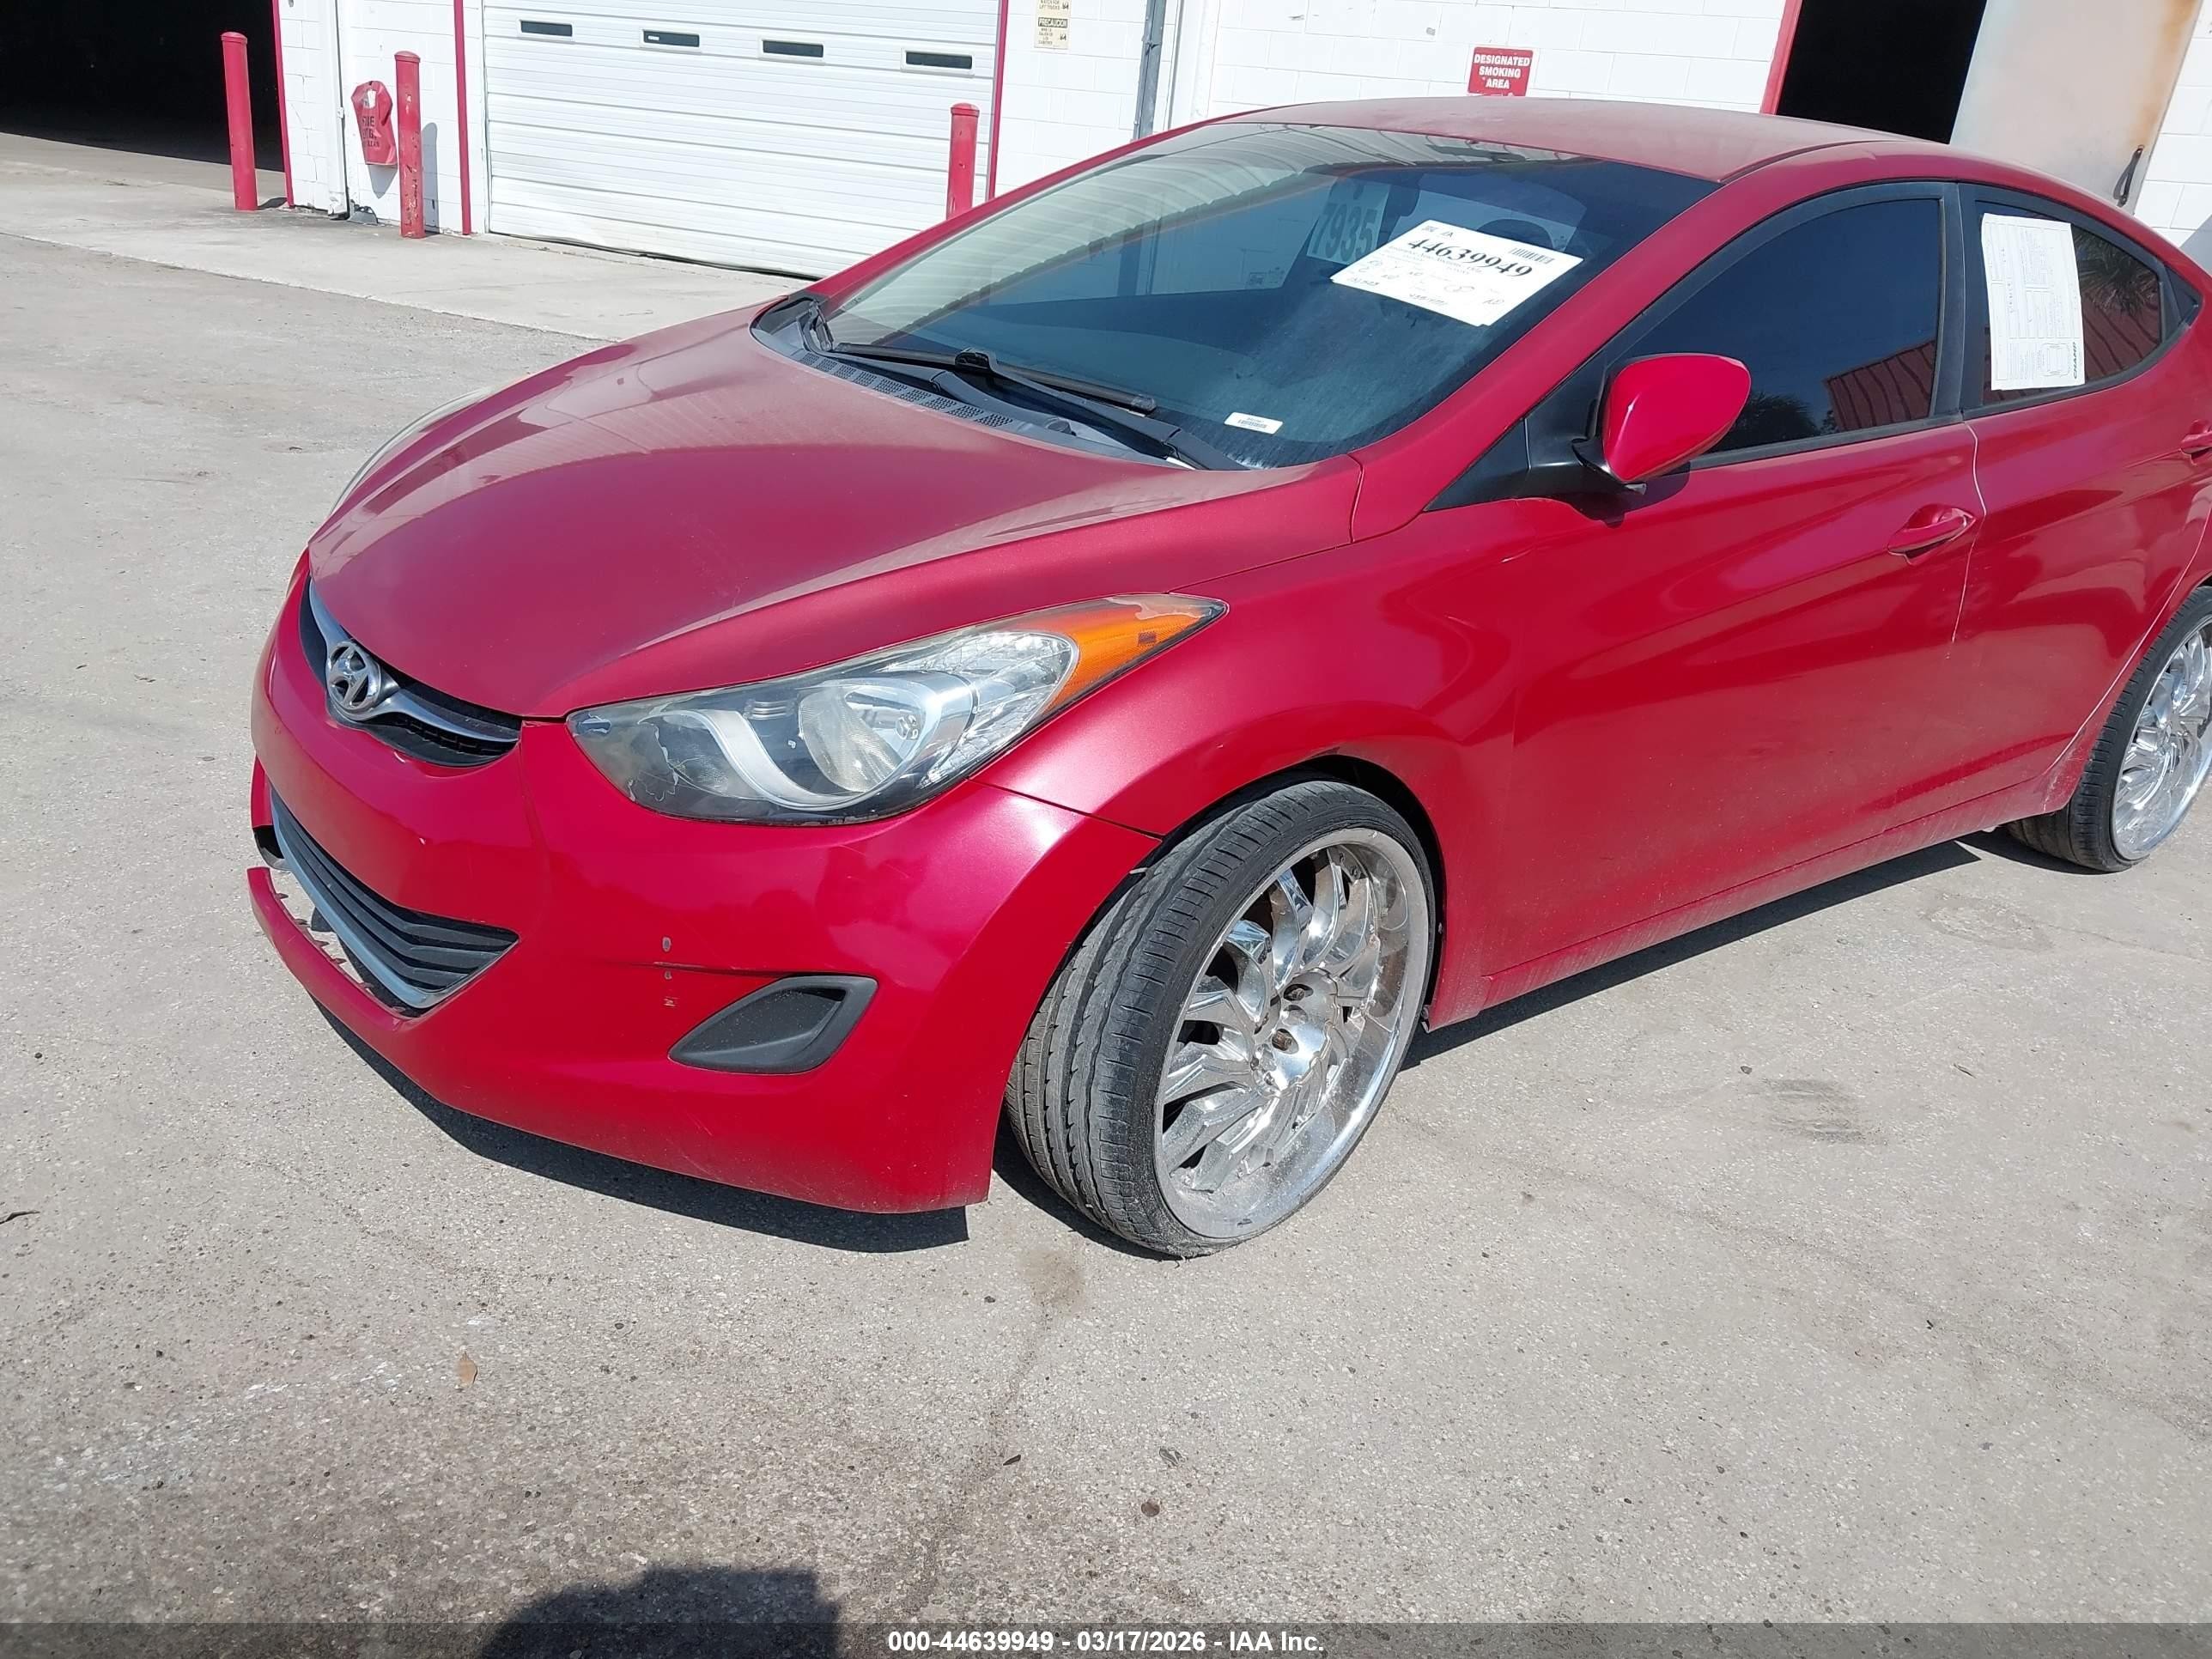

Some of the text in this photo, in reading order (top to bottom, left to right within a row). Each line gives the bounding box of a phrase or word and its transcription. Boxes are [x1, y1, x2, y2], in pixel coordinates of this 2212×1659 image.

[1474, 53, 1530, 67] DESIGNATED
[1479, 65, 1522, 79] SMOKING
[1485, 78, 1510, 89] AREA
[1313, 203, 1378, 262] 7935
[1408, 238, 1533, 277] 44639949
